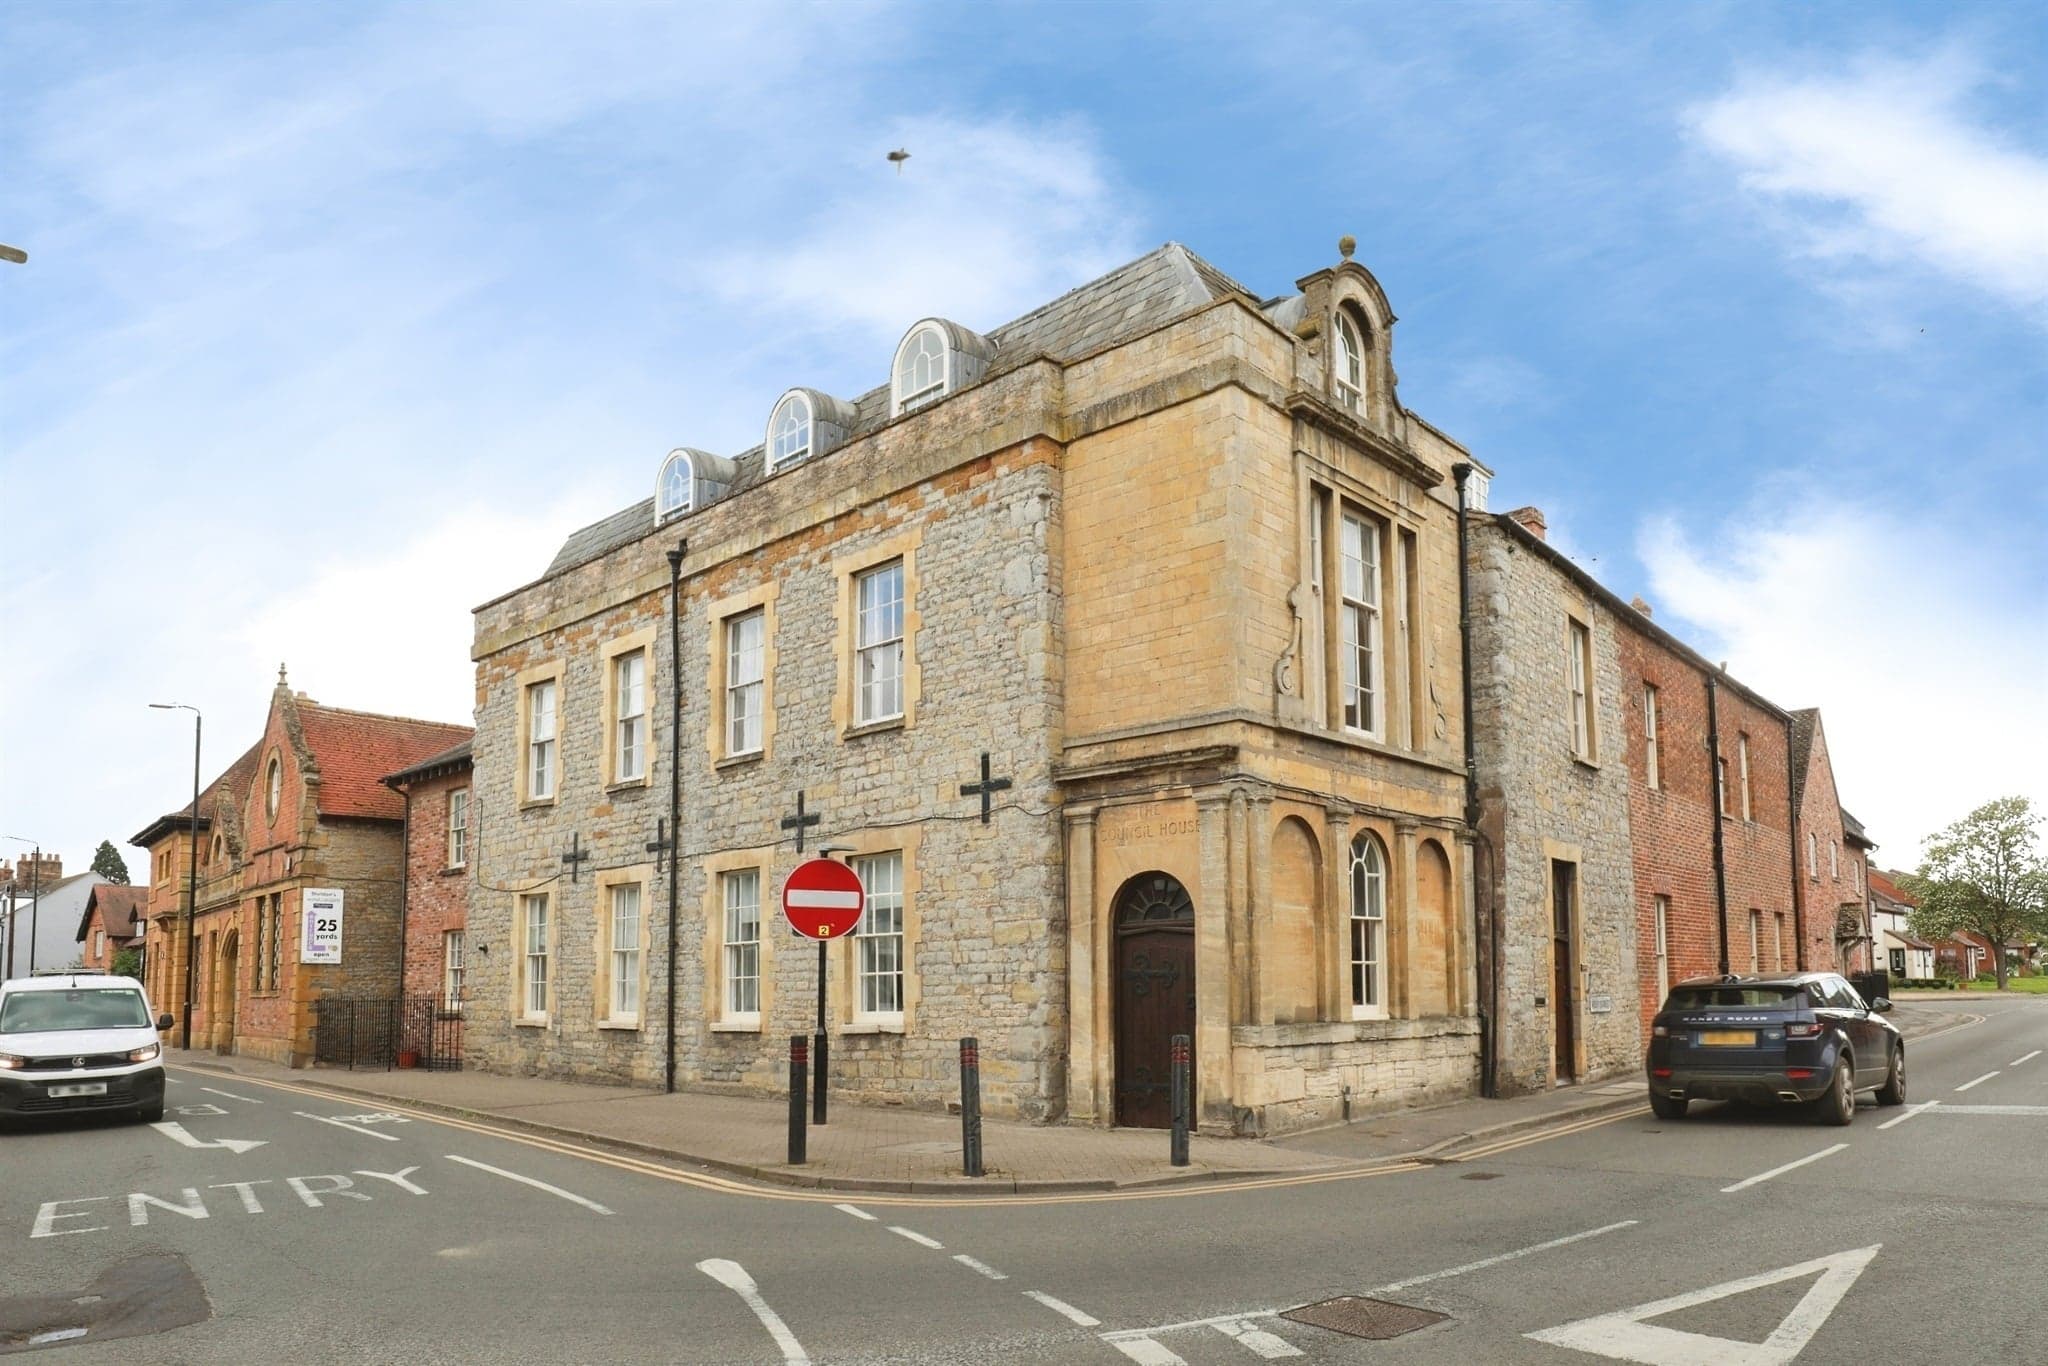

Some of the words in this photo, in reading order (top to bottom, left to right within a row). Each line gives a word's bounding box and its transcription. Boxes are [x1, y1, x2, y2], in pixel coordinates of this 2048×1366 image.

[1160, 819, 1200, 836] HOUSE
[317, 919, 337, 932] 25
[30, 1166, 430, 1238] ENTRY
